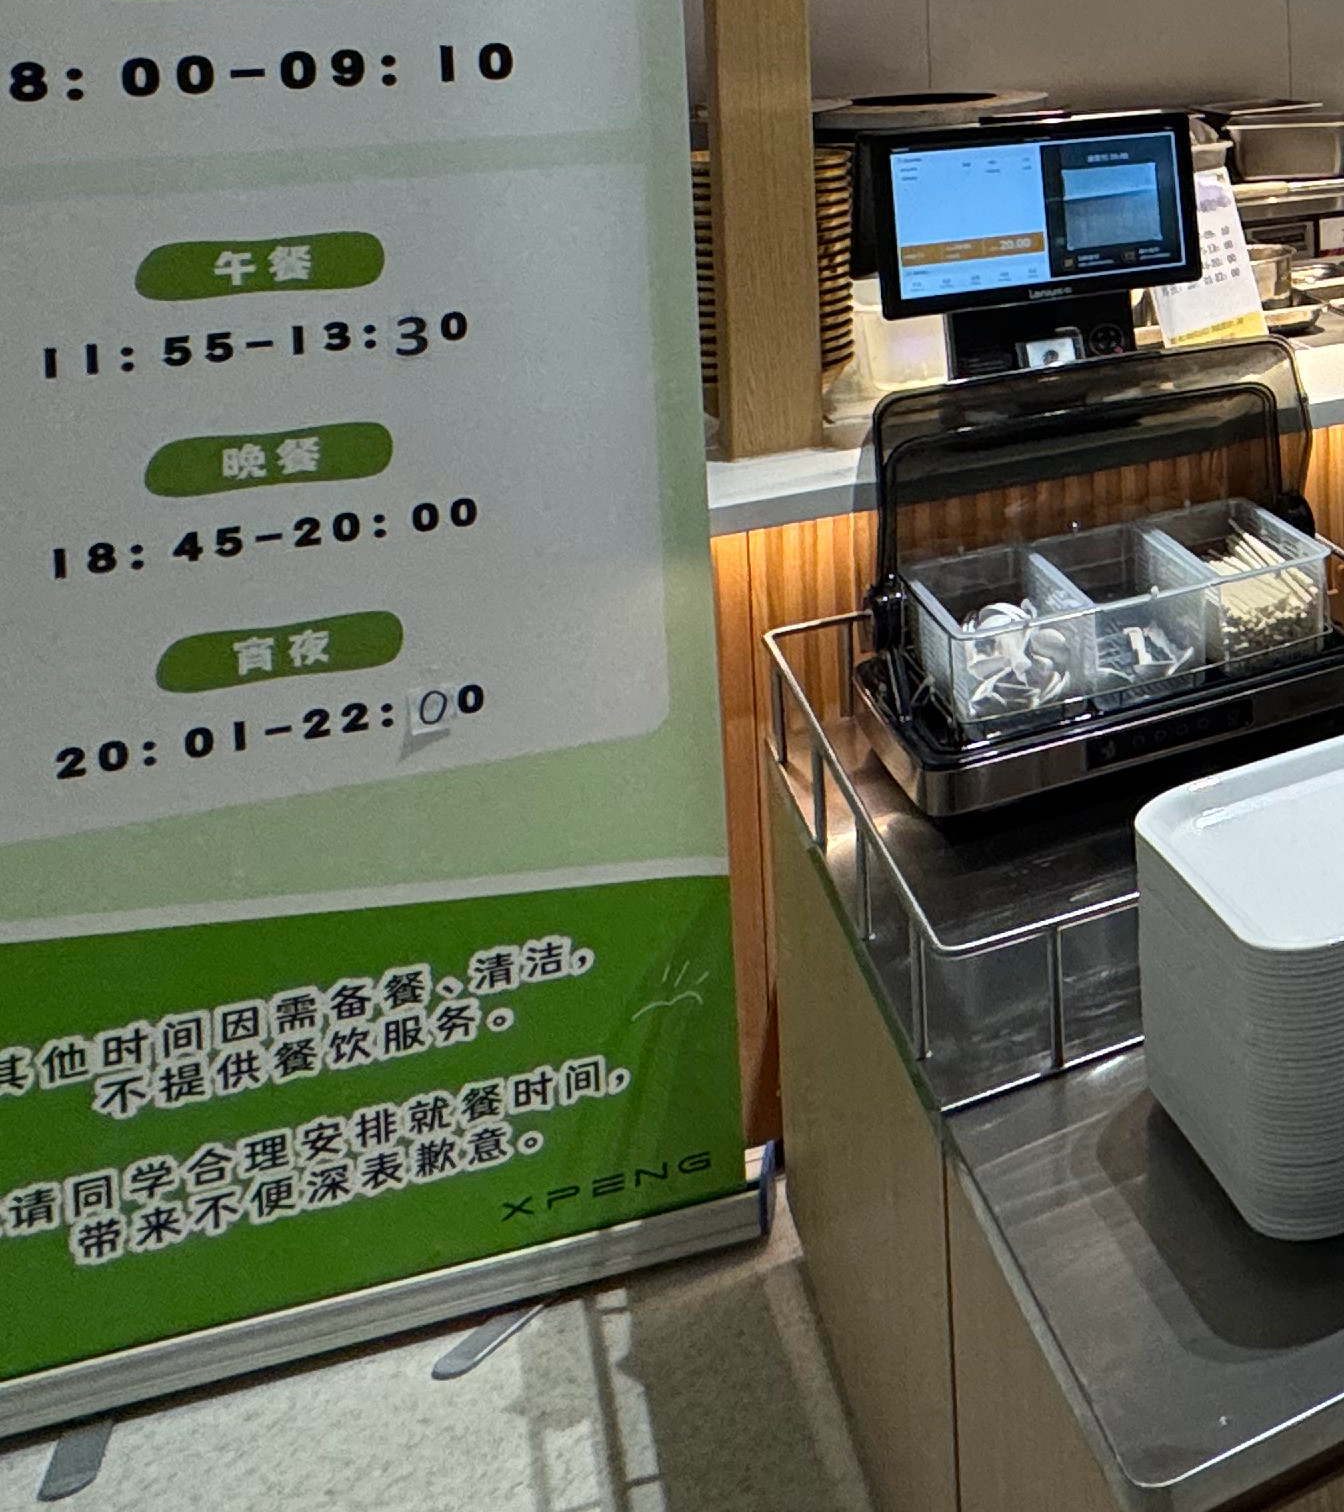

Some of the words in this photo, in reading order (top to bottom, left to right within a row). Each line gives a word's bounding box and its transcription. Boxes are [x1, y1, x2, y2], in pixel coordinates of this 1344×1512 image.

[213, 243, 313, 287] 午餐
[222, 435, 321, 481] 晚餐
[232, 629, 331, 677] 宵夜
[101, 997, 516, 1112] 不提供餐饮服务。
[78, 1128, 540, 1261] 带来不便深表歉意。
[501, 1150, 712, 1223] XPENG
